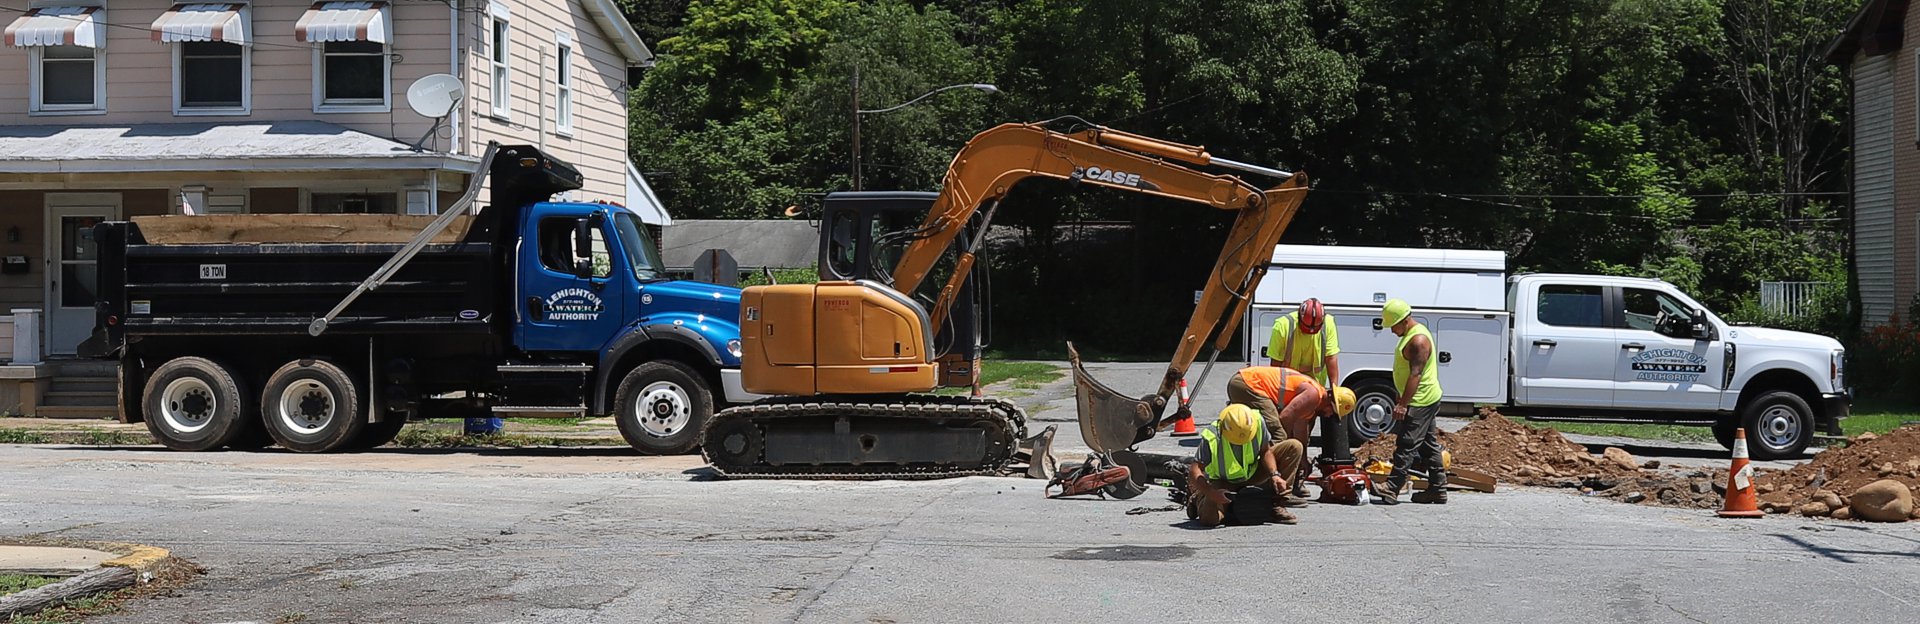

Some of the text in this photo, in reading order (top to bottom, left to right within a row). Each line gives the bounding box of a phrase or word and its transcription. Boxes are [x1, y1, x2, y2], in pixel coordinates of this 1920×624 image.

[1086, 166, 1140, 186] CASE
[202, 266, 225, 277] 18 TON
[546, 288, 602, 306] LEHIGHTON
[548, 313, 599, 321] AUTHORITY
[1632, 348, 1707, 365] LEHIGHTON
[1642, 363, 1696, 372] WATER
[1637, 372, 1700, 382] AUTHORITY
